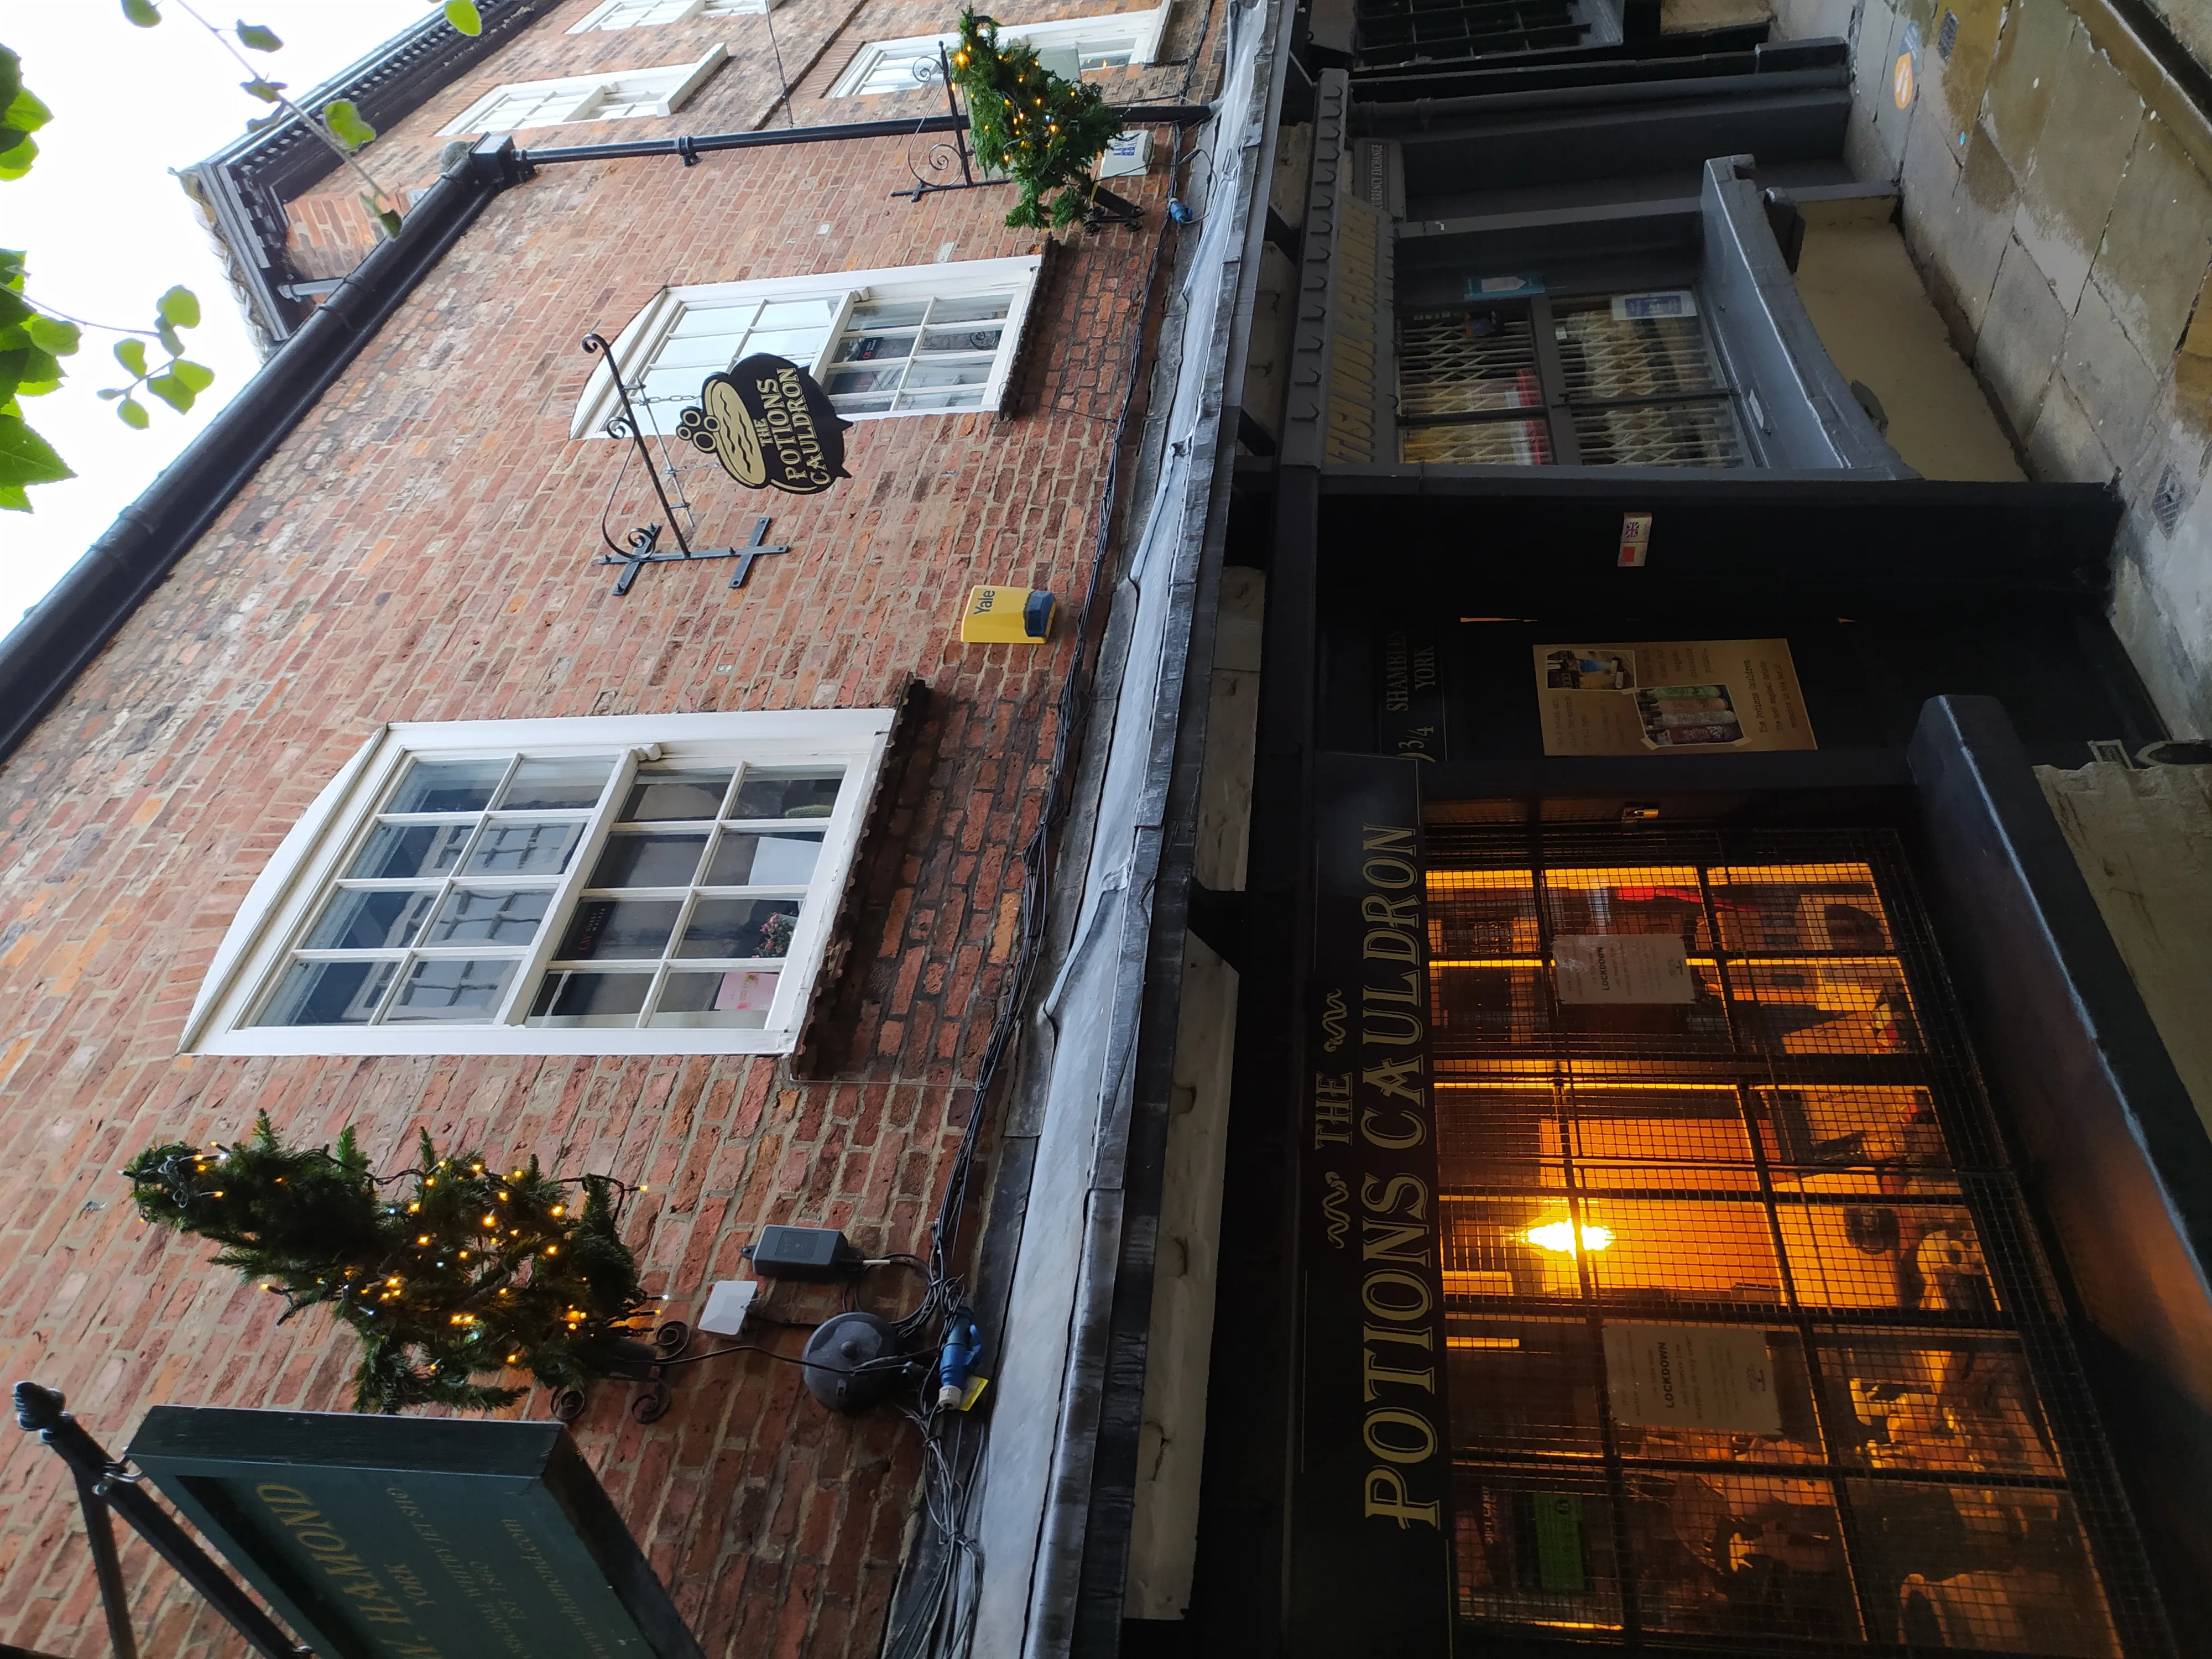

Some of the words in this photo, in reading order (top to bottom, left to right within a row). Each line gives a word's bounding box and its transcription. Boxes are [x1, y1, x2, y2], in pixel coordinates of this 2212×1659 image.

[1370, 144, 1383, 175] EXCHANGE
[1334, 201, 1379, 315] CASHMERE
[1329, 332, 1377, 401] WOOL
[754, 418, 774, 447] THE
[756, 378, 806, 481] POTIONS
[776, 367, 831, 486] CAULDRON
[973, 590, 996, 615] Yale
[1386, 630, 1409, 711] SHAMBLES
[1413, 645, 1436, 690] YORK
[1743, 659, 1757, 690] Cauldron
[1750, 692, 1765, 718] Potions
[1758, 721, 1768, 733] The
[1359, 821, 1427, 1149] CAULDRON
[1596, 947, 1610, 991] LOCKDOWN
[1314, 1072, 1353, 1150] THE
[1360, 1172, 1441, 1530] POTIONS
[1657, 1342, 1675, 1408] LOCKDOWN
[257, 1483, 414, 1625] HAMOND
[384, 1563, 437, 1607] YORK
